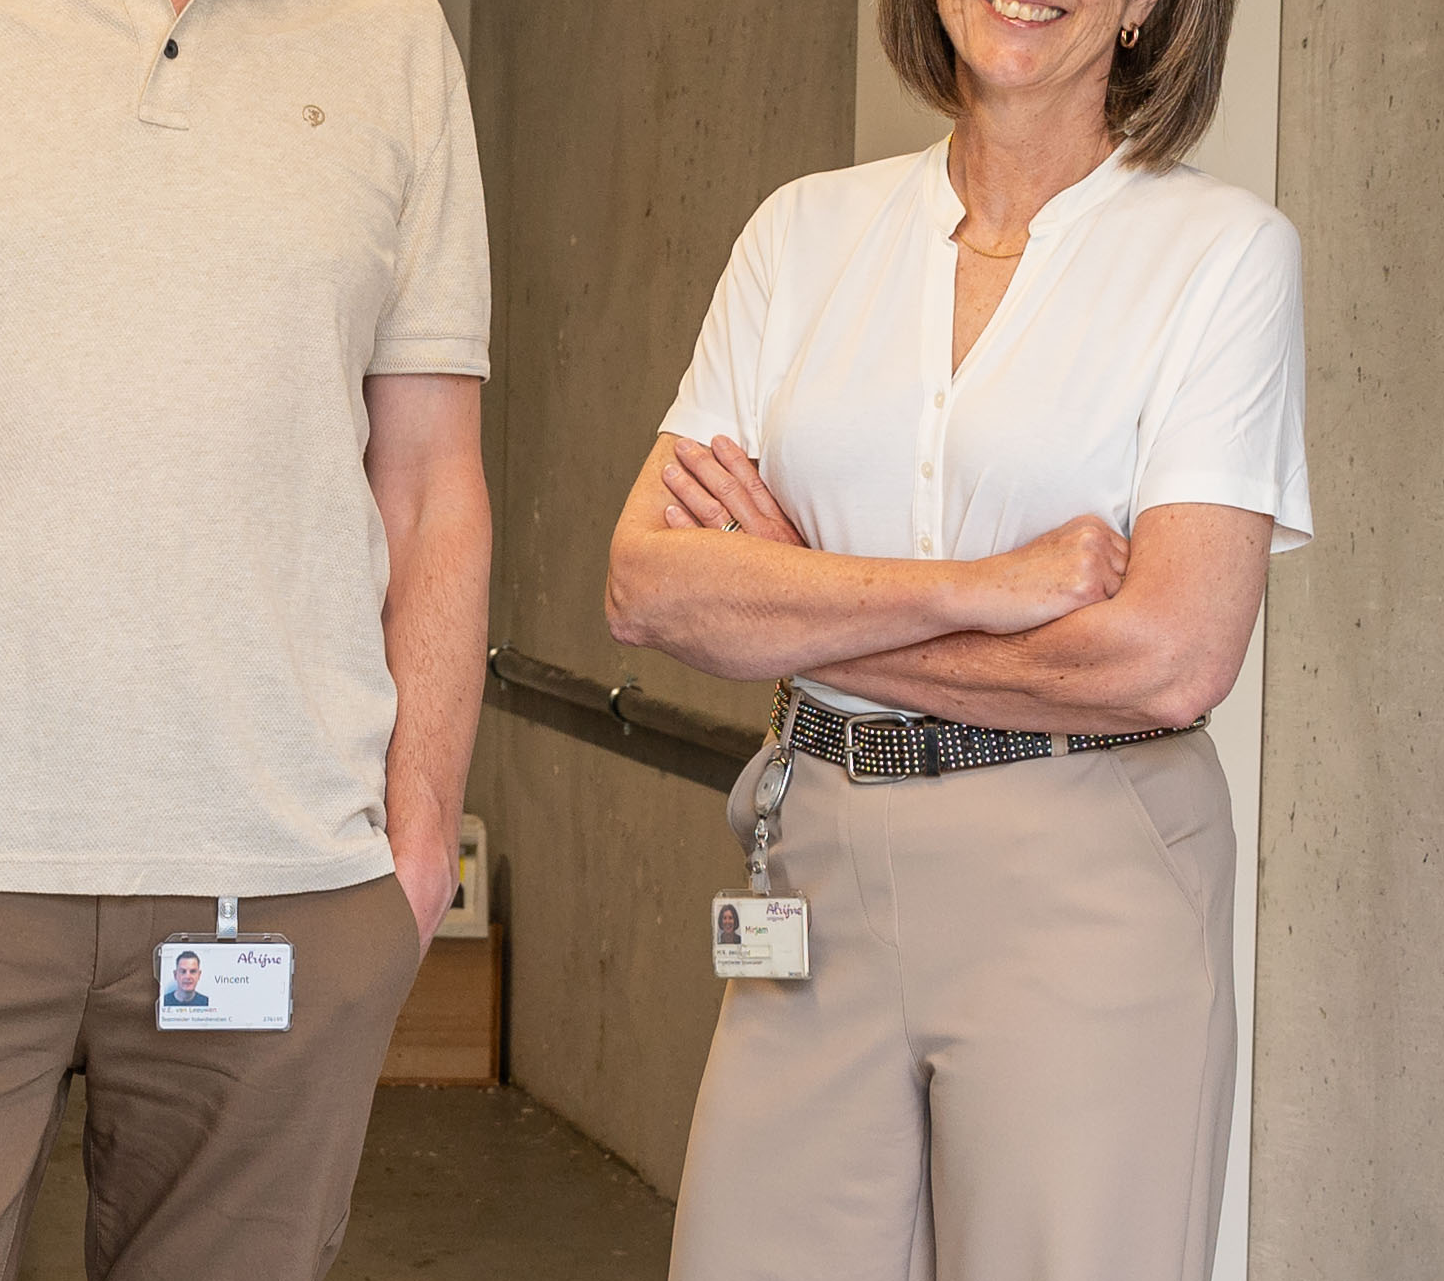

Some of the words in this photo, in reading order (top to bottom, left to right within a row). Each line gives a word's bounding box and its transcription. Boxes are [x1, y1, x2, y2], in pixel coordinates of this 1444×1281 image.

[746, 925, 768, 936] Mirjam
[237, 951, 282, 968] Alrijne
[214, 975, 250, 984] Vincent
